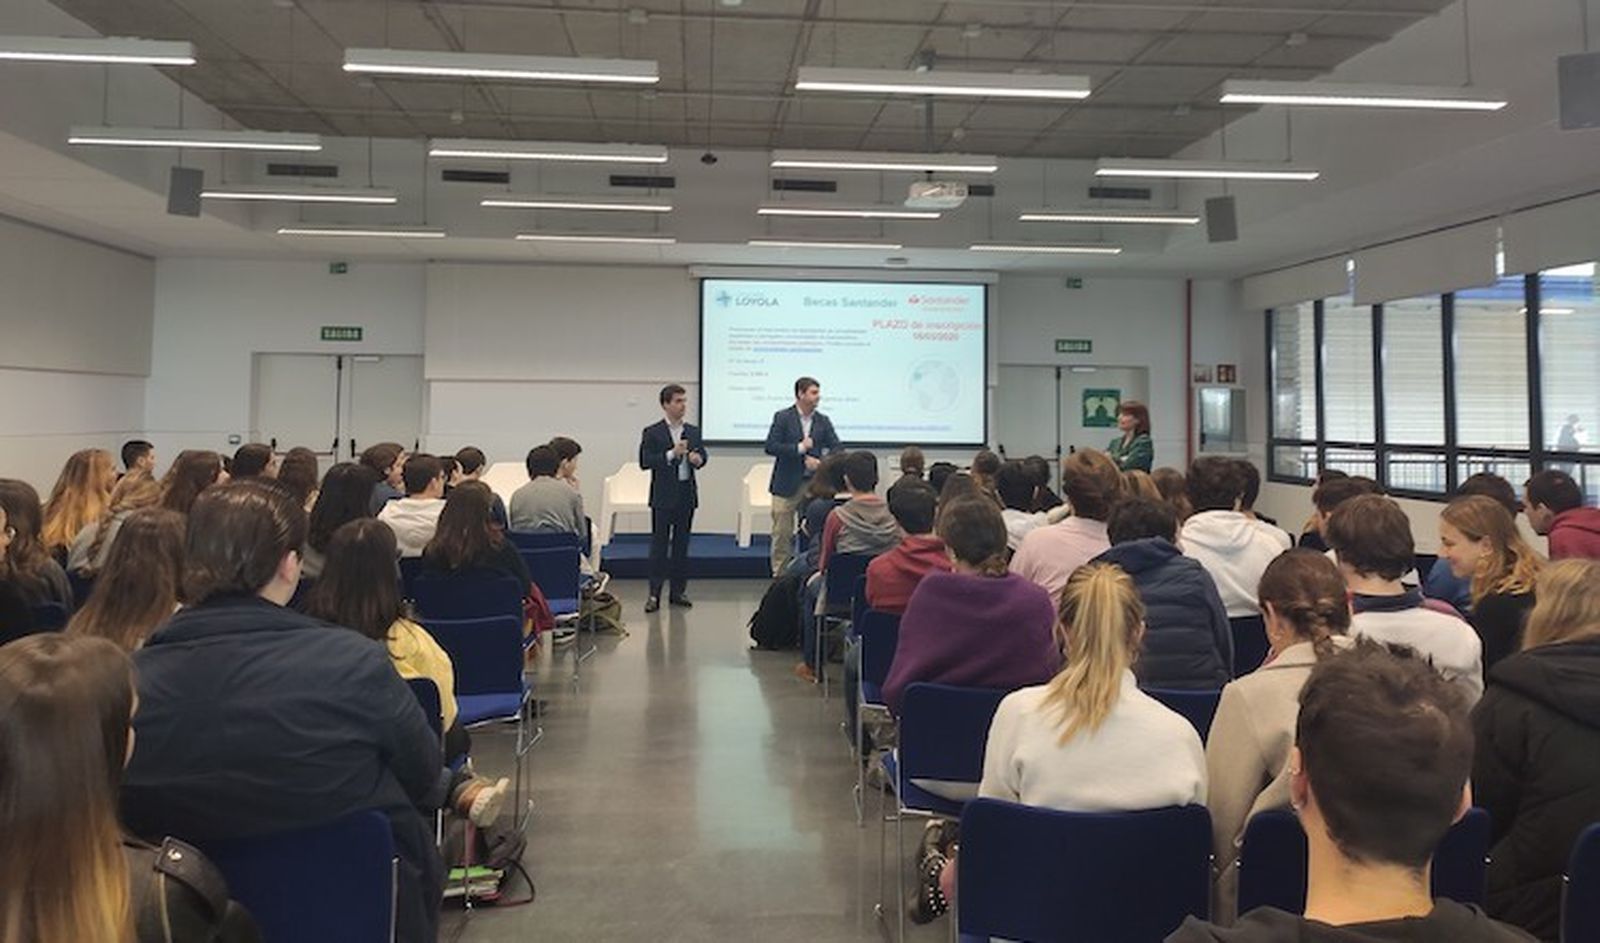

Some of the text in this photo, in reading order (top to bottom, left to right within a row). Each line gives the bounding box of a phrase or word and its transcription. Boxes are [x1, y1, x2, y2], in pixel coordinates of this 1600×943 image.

[735, 297, 780, 306] LOYOLA
[803, 296, 898, 308] Becas Santander
[872, 319, 906, 330] PLAZO
[323, 329, 359, 339] SALIDA
[1057, 341, 1089, 351] SALIDA
